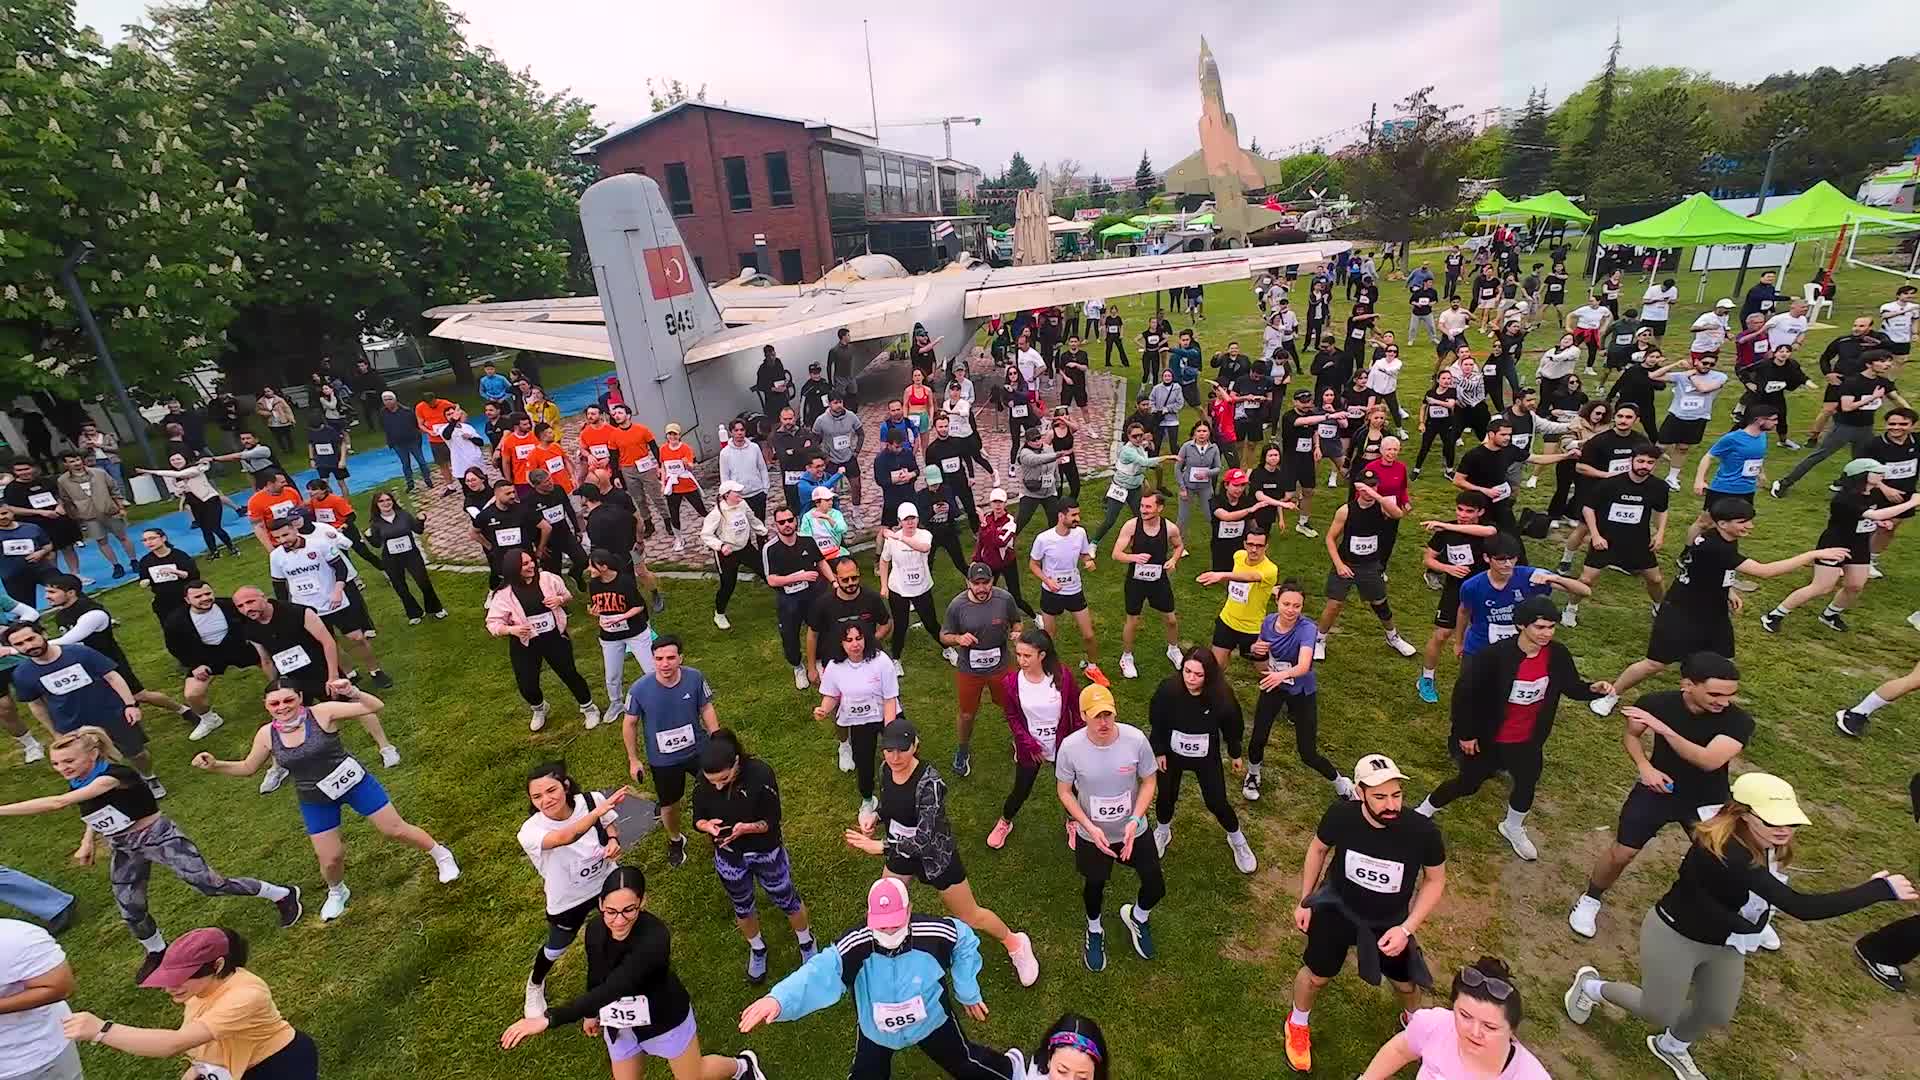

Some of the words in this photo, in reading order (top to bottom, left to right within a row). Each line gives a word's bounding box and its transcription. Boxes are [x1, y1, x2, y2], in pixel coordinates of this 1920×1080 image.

[1615, 510, 1634, 518] 636
[907, 573, 919, 581] 110
[281, 655, 300, 667] 827
[53, 675, 80, 690] 892
[851, 704, 872, 714] 299
[1034, 726, 1056, 737] 753
[665, 736, 688, 747] 454
[1178, 742, 1200, 752] 165
[333, 769, 357, 792] 766
[1096, 803, 1121, 816] 626
[1356, 868, 1391, 885] 659
[608, 1007, 634, 1022] 315
[885, 1013, 917, 1028] 685
